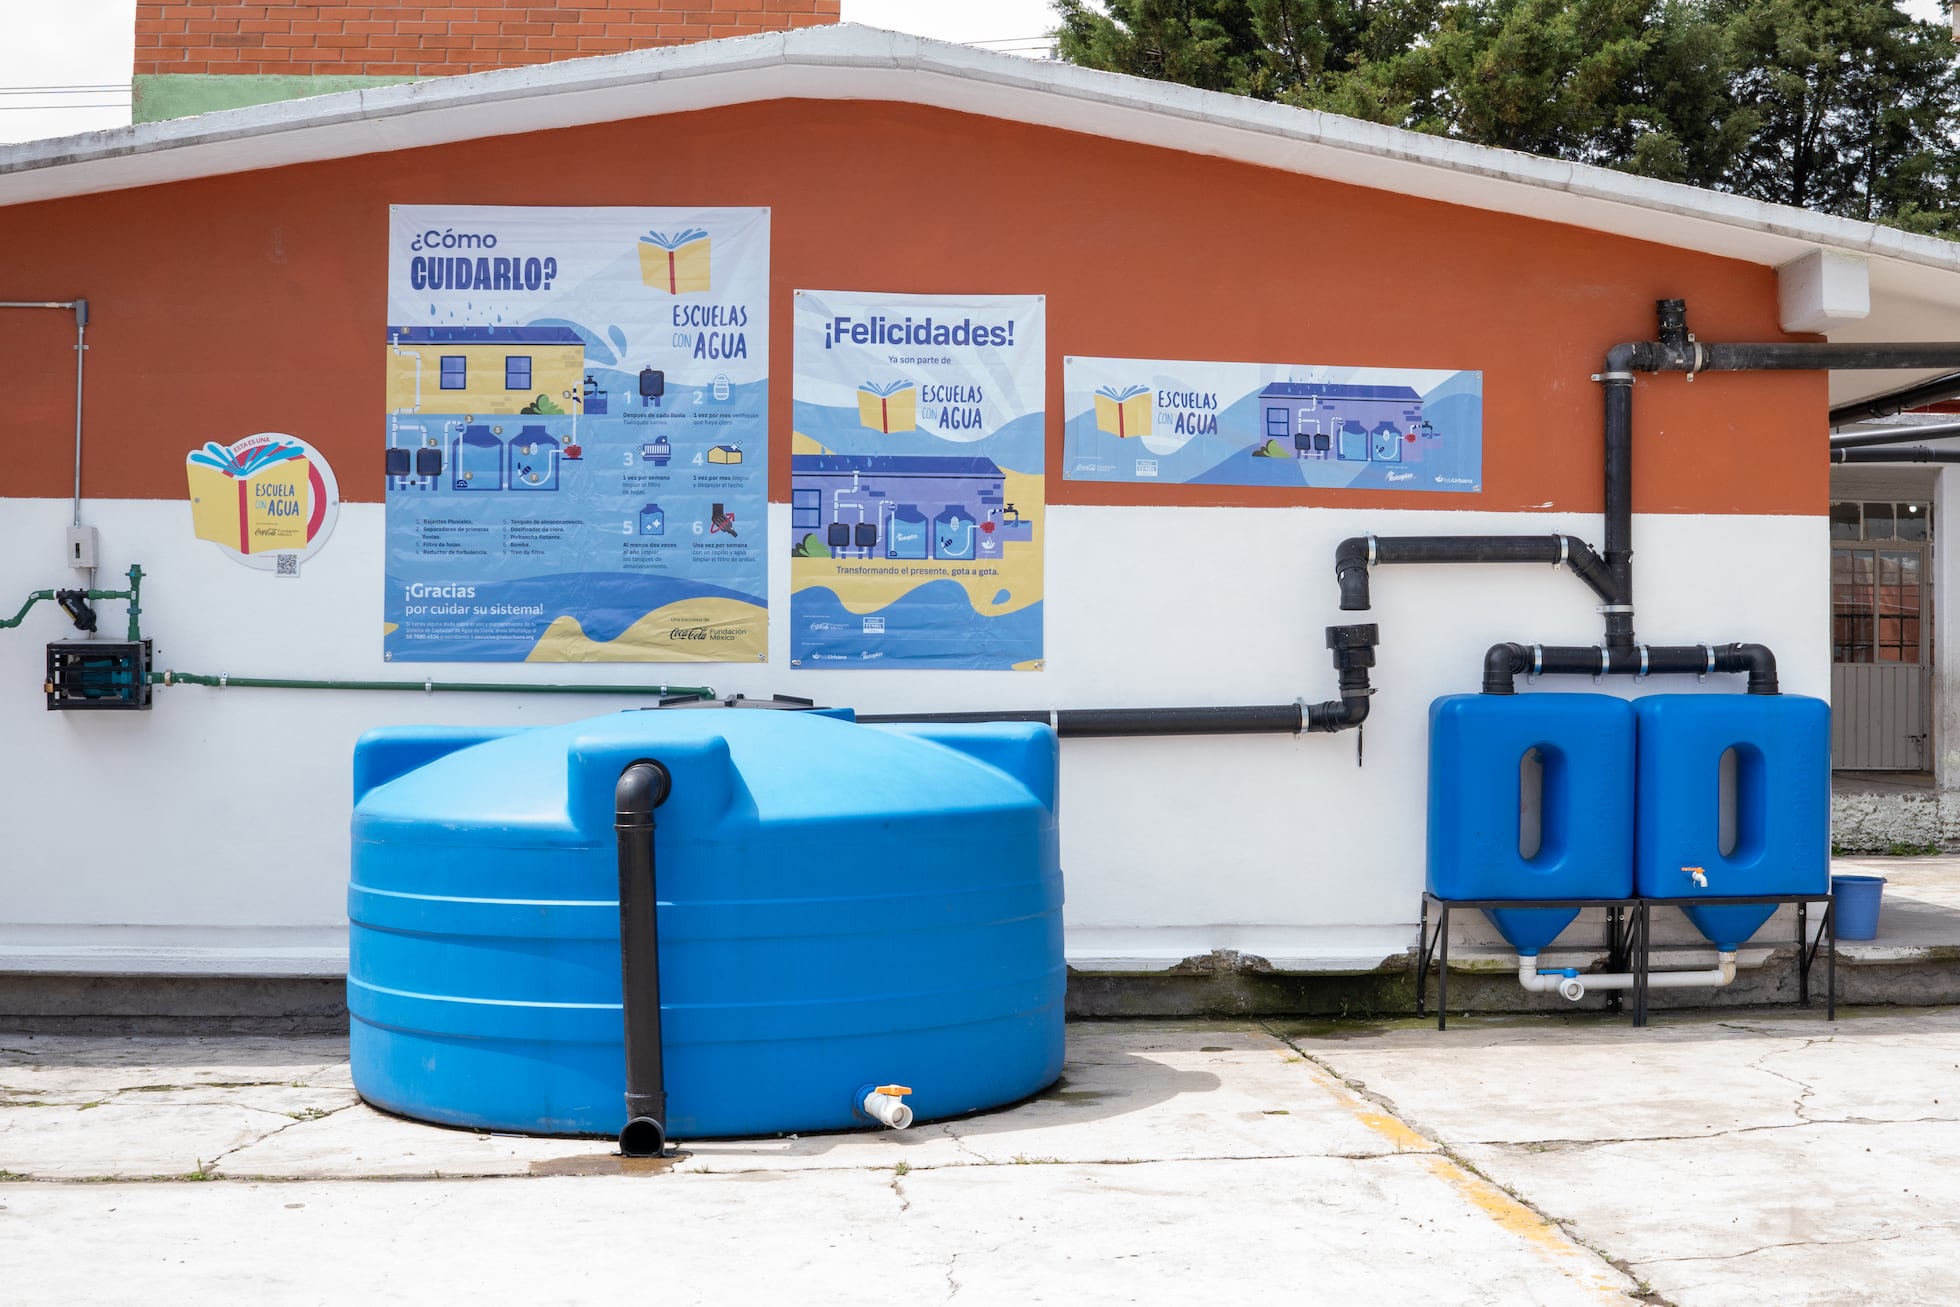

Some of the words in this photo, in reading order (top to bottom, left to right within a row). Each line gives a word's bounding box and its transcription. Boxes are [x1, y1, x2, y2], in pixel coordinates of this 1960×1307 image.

[410, 228, 498, 252] ¿Cómo
[410, 256, 558, 292] CUIDARLO?
[672, 304, 748, 328] ESCUELAS
[825, 316, 1015, 349] ¡Felicidades!
[672, 332, 692, 348] CON
[693, 331, 748, 360] AGUA
[888, 355, 899, 364] Ya
[917, 356, 939, 366] parte
[941, 356, 952, 364] de
[624, 390, 632, 404] 1
[692, 391, 703, 404] 2
[922, 384, 983, 403] ESCUELAS
[1157, 390, 1218, 410] ESCUELAS
[922, 408, 937, 420] CON
[938, 406, 983, 430] AGUA
[1157, 412, 1173, 425] CON
[1175, 412, 1218, 436] AGUA
[624, 452, 634, 466] 3
[692, 452, 704, 466] 4
[255, 483, 295, 497] ESCUELA
[267, 499, 300, 517] AGUA
[623, 520, 633, 534] 5
[692, 520, 703, 534] 6
[836, 566, 899, 575] Transformando
[901, 566, 909, 575] el
[910, 567, 950, 578] presente,
[952, 568, 970, 577] gota
[978, 568, 999, 578] gota.
[405, 582, 476, 602] ¡Gracias
[406, 605, 428, 616] por
[431, 603, 470, 615] cuidar
[473, 606, 487, 615] su
[490, 603, 544, 615] sistema!
